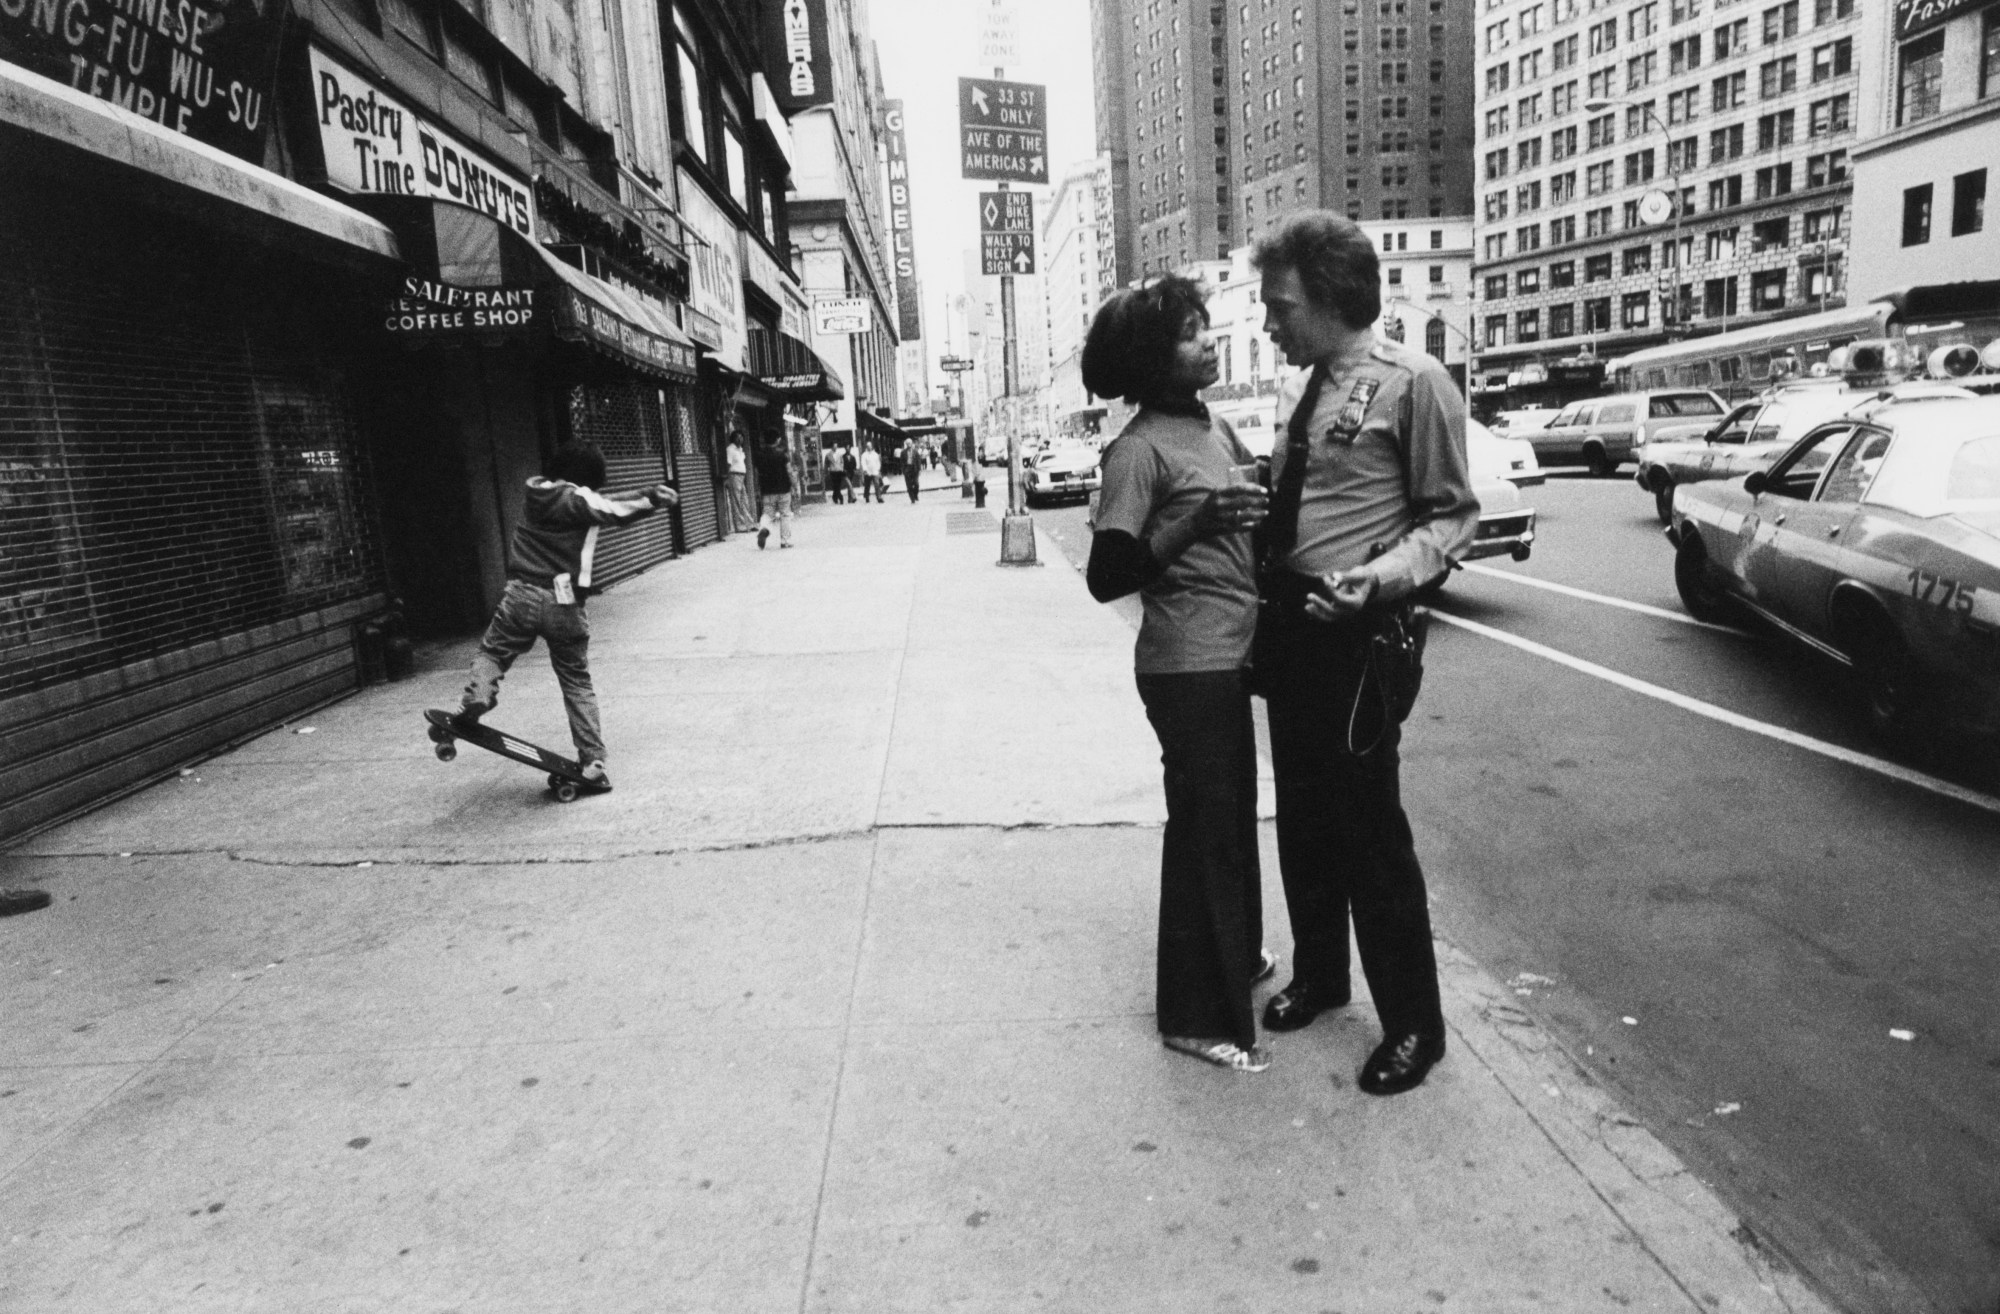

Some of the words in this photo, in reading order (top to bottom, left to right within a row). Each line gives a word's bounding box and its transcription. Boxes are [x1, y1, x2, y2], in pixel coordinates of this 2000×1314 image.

[104, 0, 208, 54] NESE
[986, 14, 1010, 25] TOW
[982, 29, 1016, 40] AWAY
[984, 44, 1016, 56] ZONE
[170, 48, 261, 130] WU-SU
[998, 88, 1014, 105] 33
[1020, 90, 1035, 106] ST
[319, 70, 402, 155] Pastry
[1000, 108, 1034, 125] ONLY
[967, 132, 991, 149] AVE
[997, 134, 1013, 149] OF
[1020, 135, 1042, 152] THE
[354, 137, 415, 195] Time
[966, 154, 1027, 172] AMERICAS
[419, 129, 530, 235] DONUTS
[885, 109, 914, 278] GIMBELS
[1006, 193, 1027, 205] END
[1006, 206, 1029, 218] BIKE
[1005, 218, 1031, 230] LANE
[985, 235, 1013, 247] WALK
[1018, 235, 1031, 247] TO
[985, 247, 1013, 259] NEXT
[986, 261, 1012, 273] SIGN
[385, 312, 465, 331] COFFEE
[474, 309, 533, 326] SHOP
[1908, 569, 1974, 617] 1775
